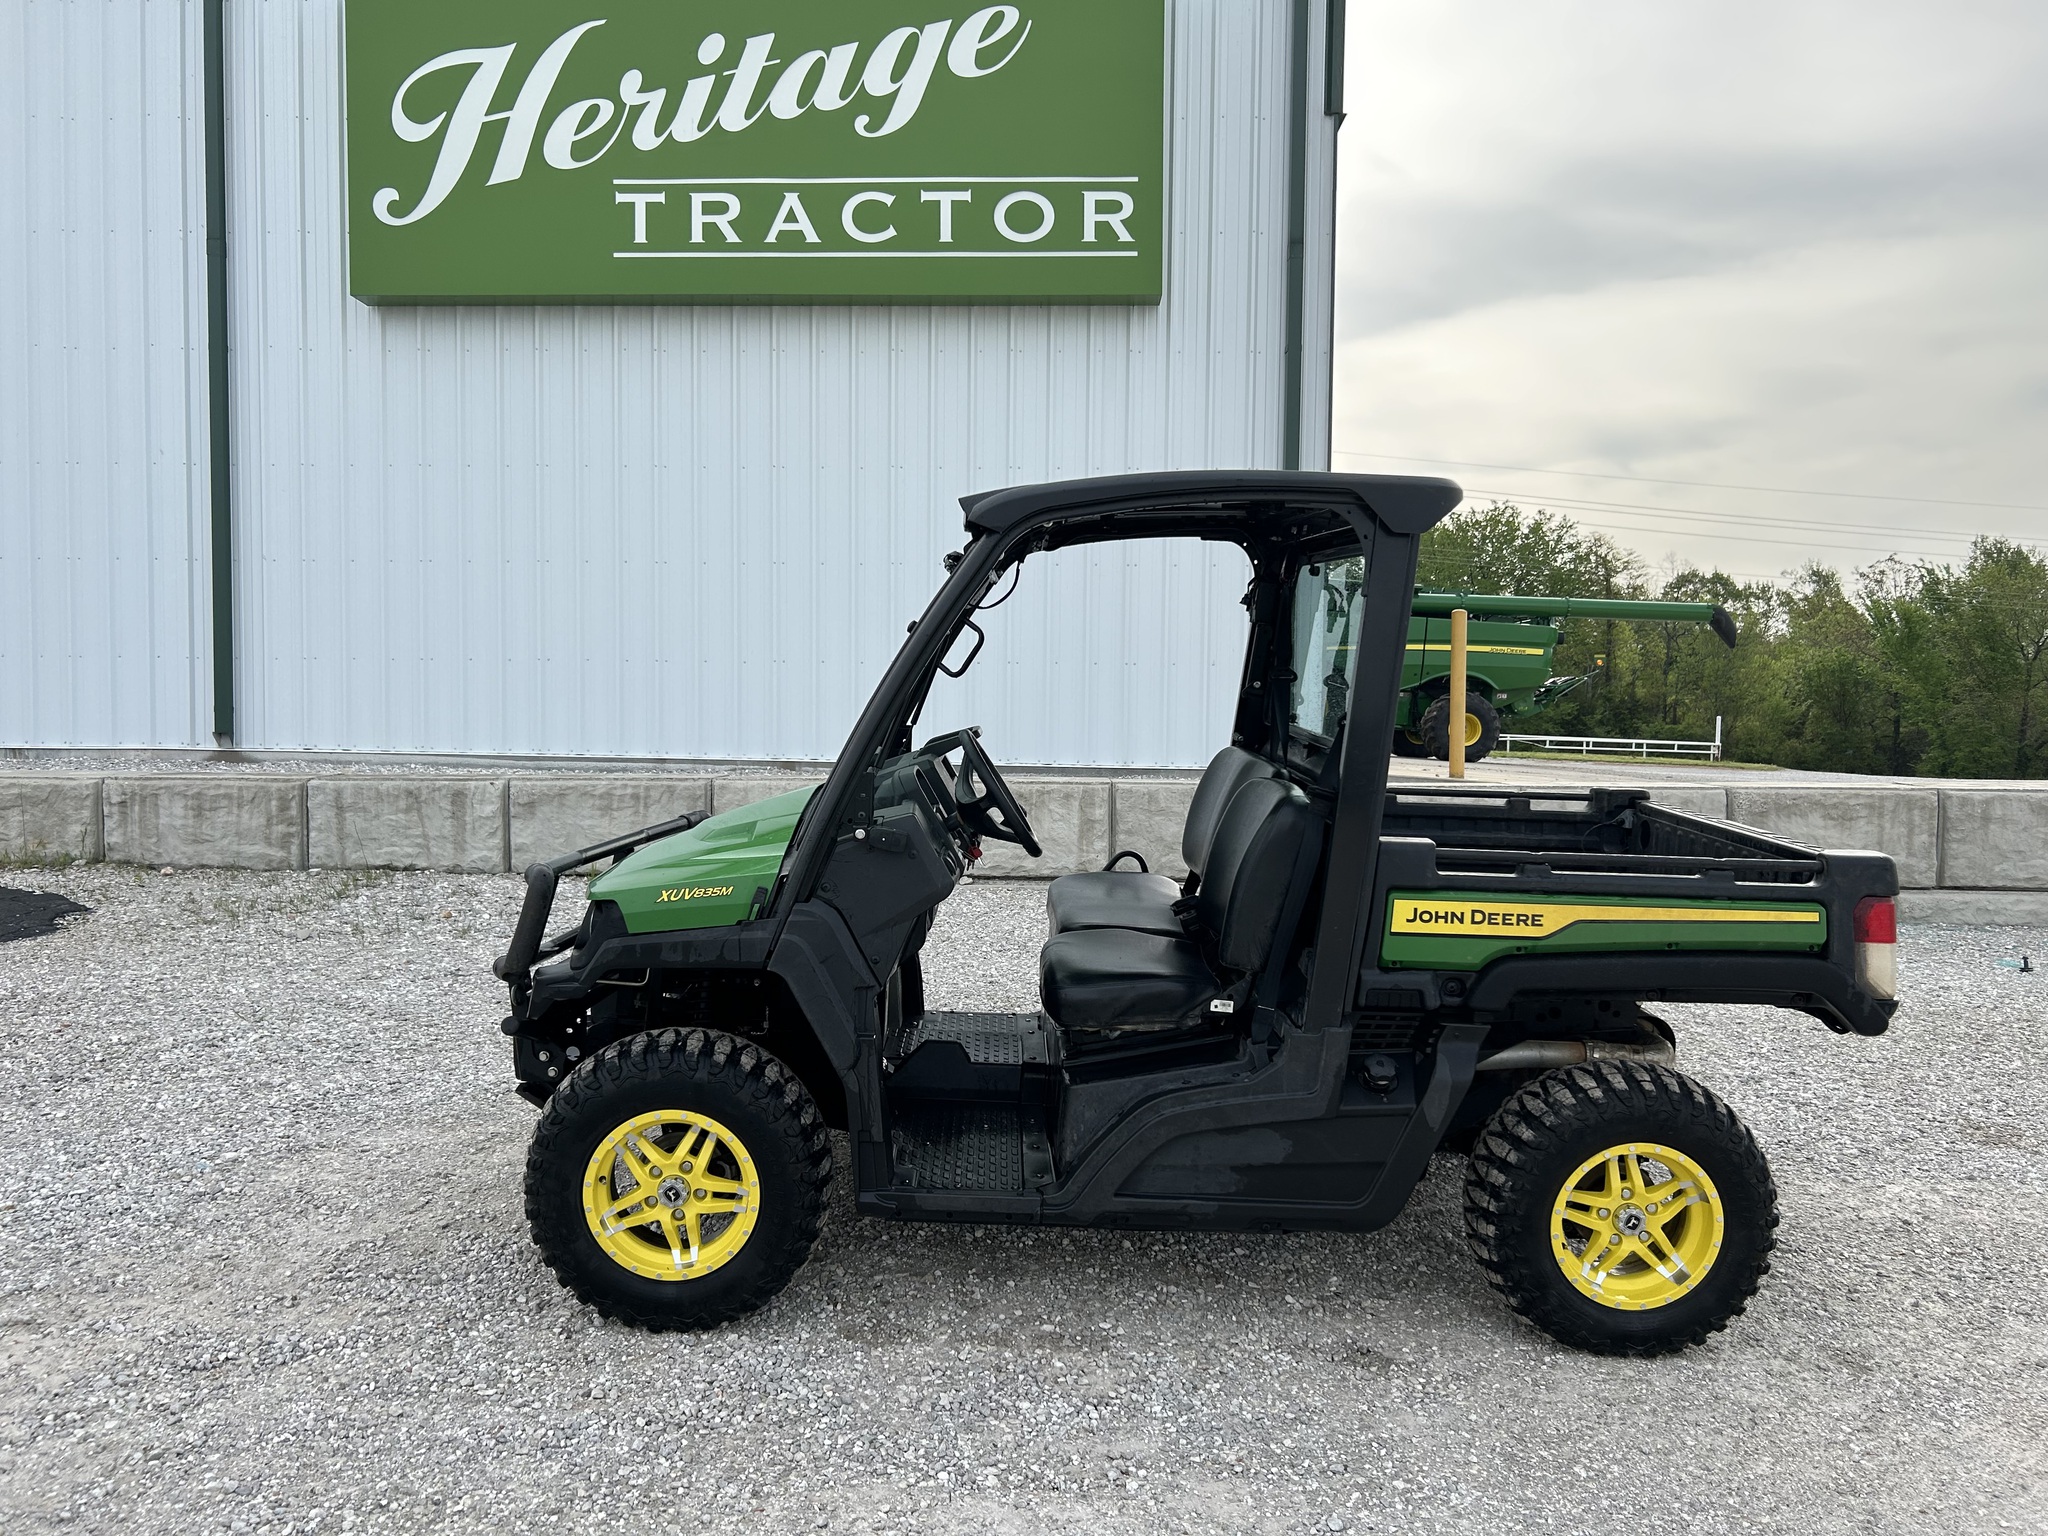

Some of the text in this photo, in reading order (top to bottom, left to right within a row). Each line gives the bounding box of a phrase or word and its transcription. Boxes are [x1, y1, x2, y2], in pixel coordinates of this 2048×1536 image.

[372, 5, 1033, 227] Heritage
[614, 189, 1137, 245] TRACTOR
[655, 885, 734, 904] XUV835M
[1405, 907, 1544, 927] JOHN DEERE
